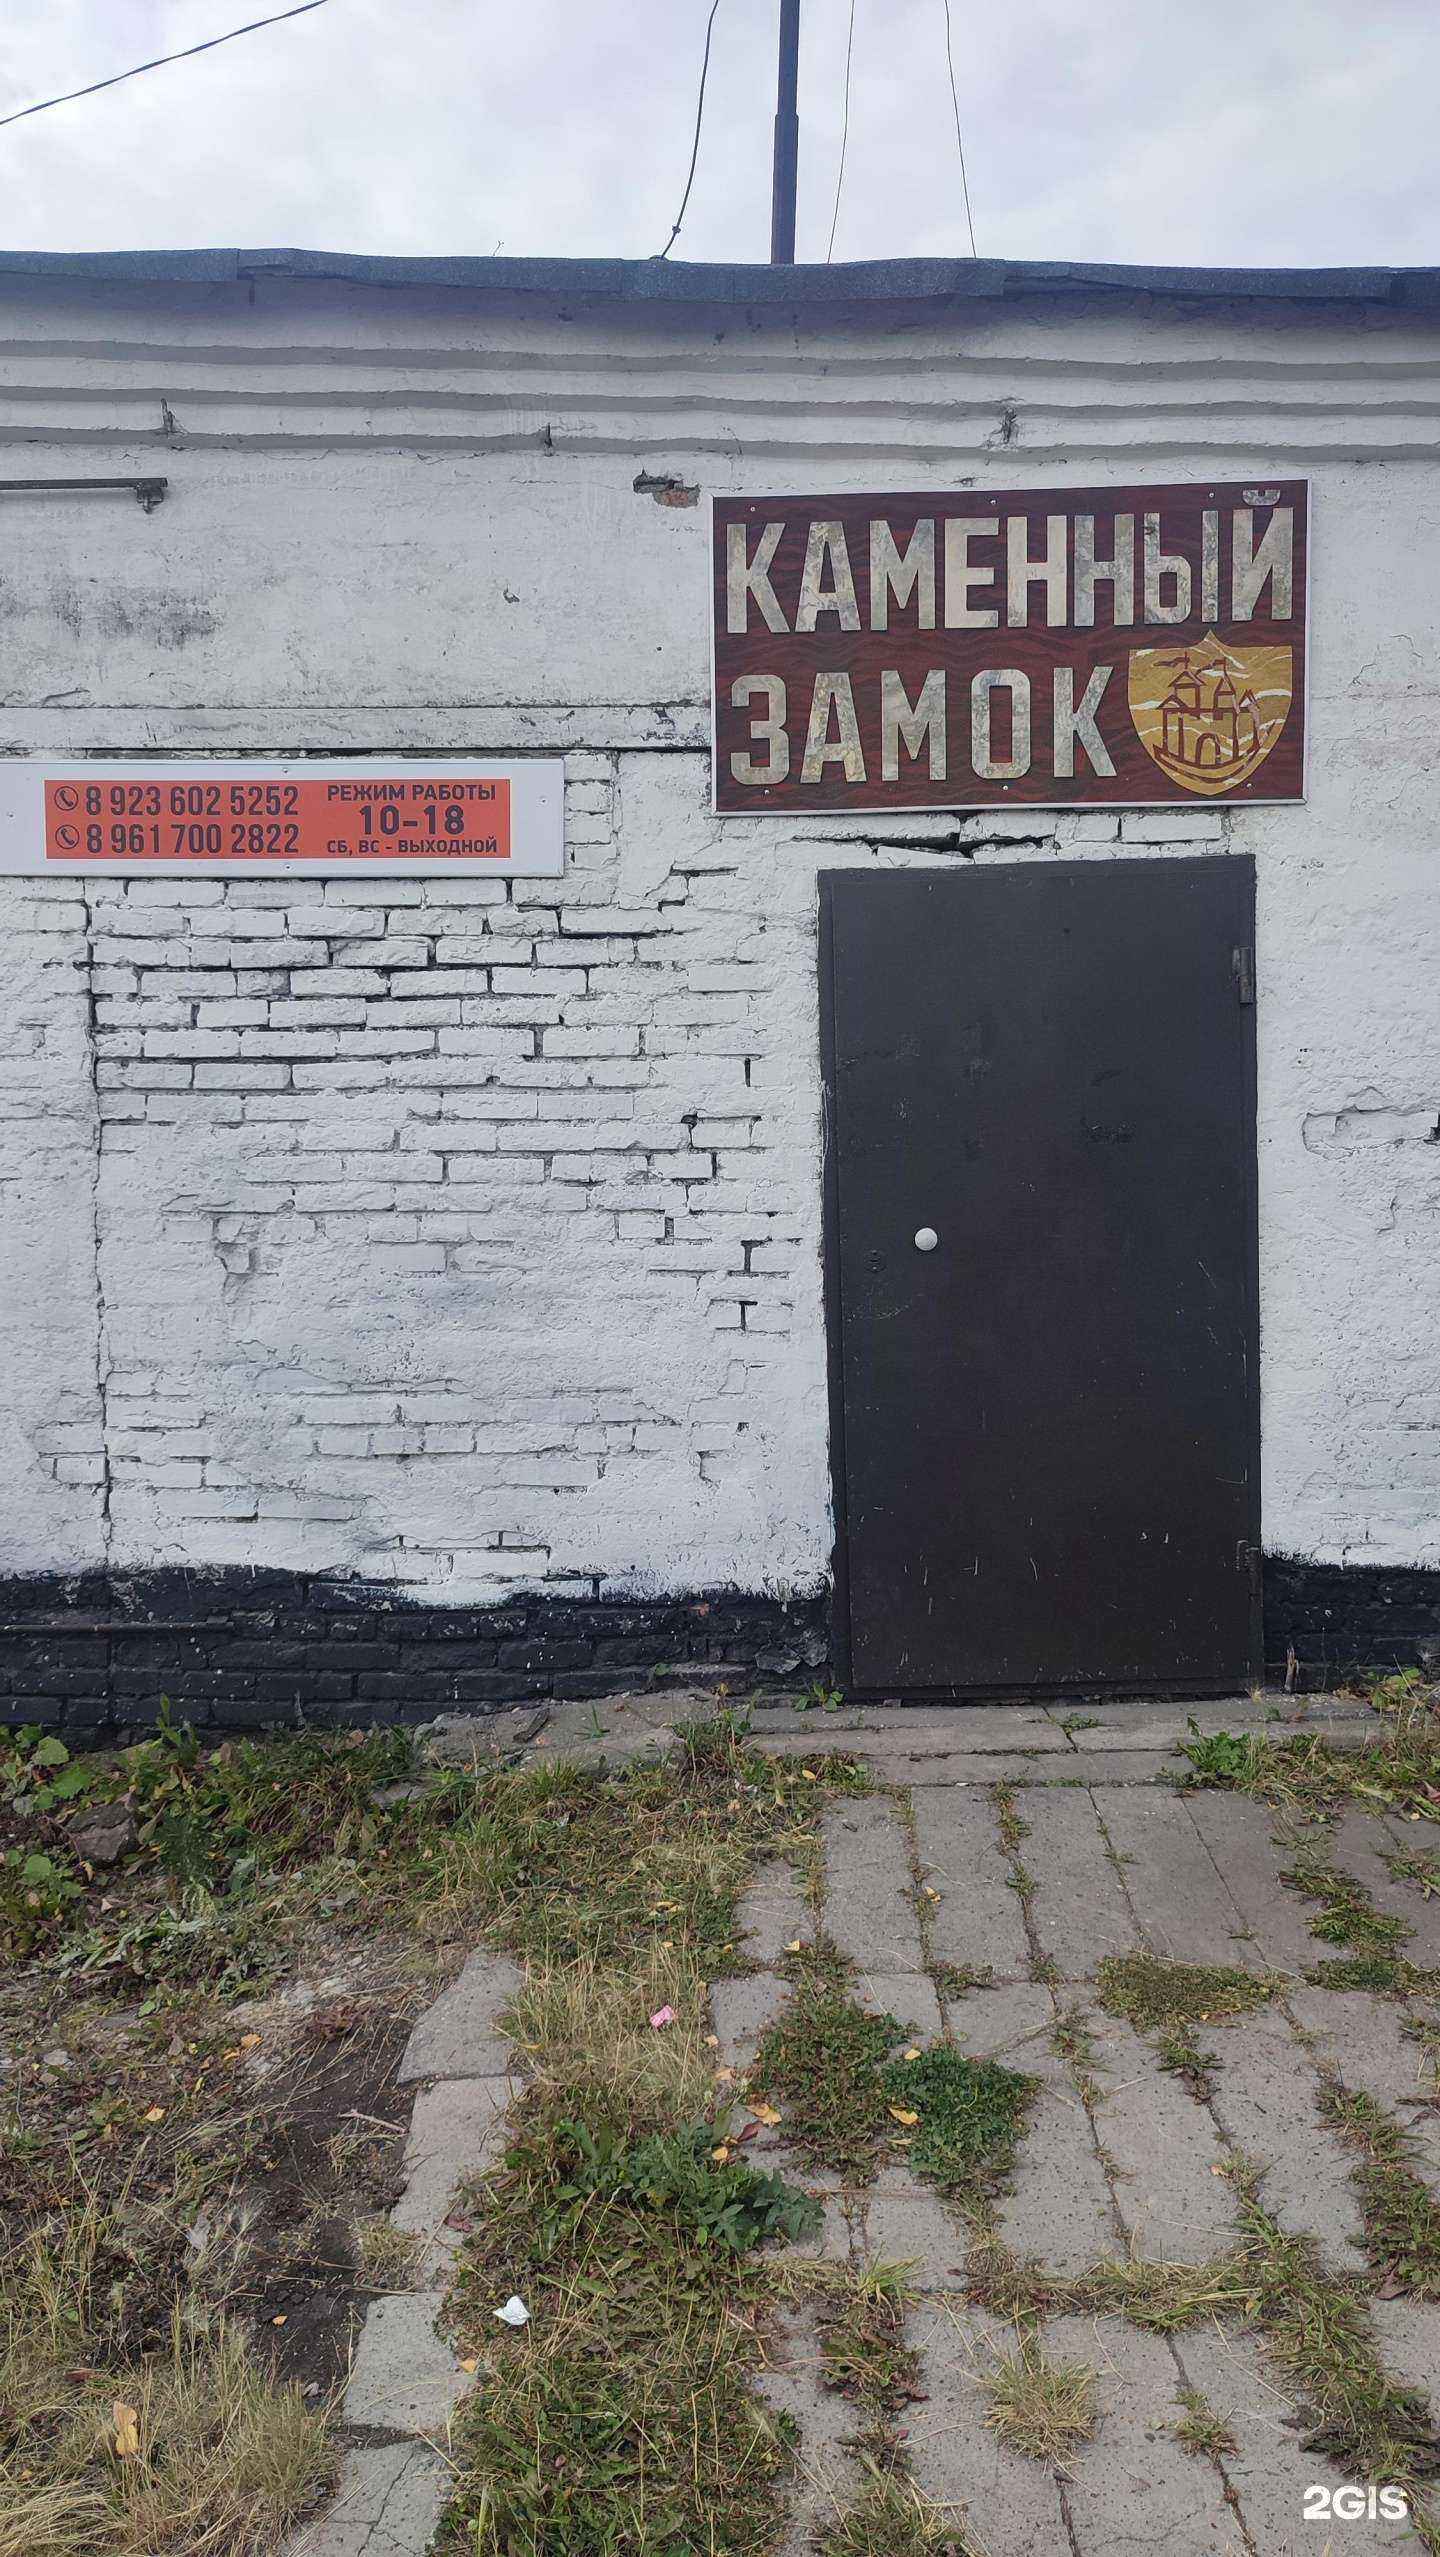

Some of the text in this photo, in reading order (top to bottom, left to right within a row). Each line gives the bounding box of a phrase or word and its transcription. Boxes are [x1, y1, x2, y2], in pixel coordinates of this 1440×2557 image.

[726, 488, 1294, 634] КАМЕННЫЙ
[730, 666, 1117, 786] ЗАМОК
[85, 785, 299, 816] 8 923 602 5252
[327, 784, 496, 801] РЕЖИМ РАБОТЫ
[359, 804, 465, 835] 10-18
[86, 823, 299, 853] 8 961 700 2822
[327, 839, 353, 857] СБ,
[358, 839, 380, 854] ВС
[398, 836, 498, 856] ВЫХОДНОЙ
